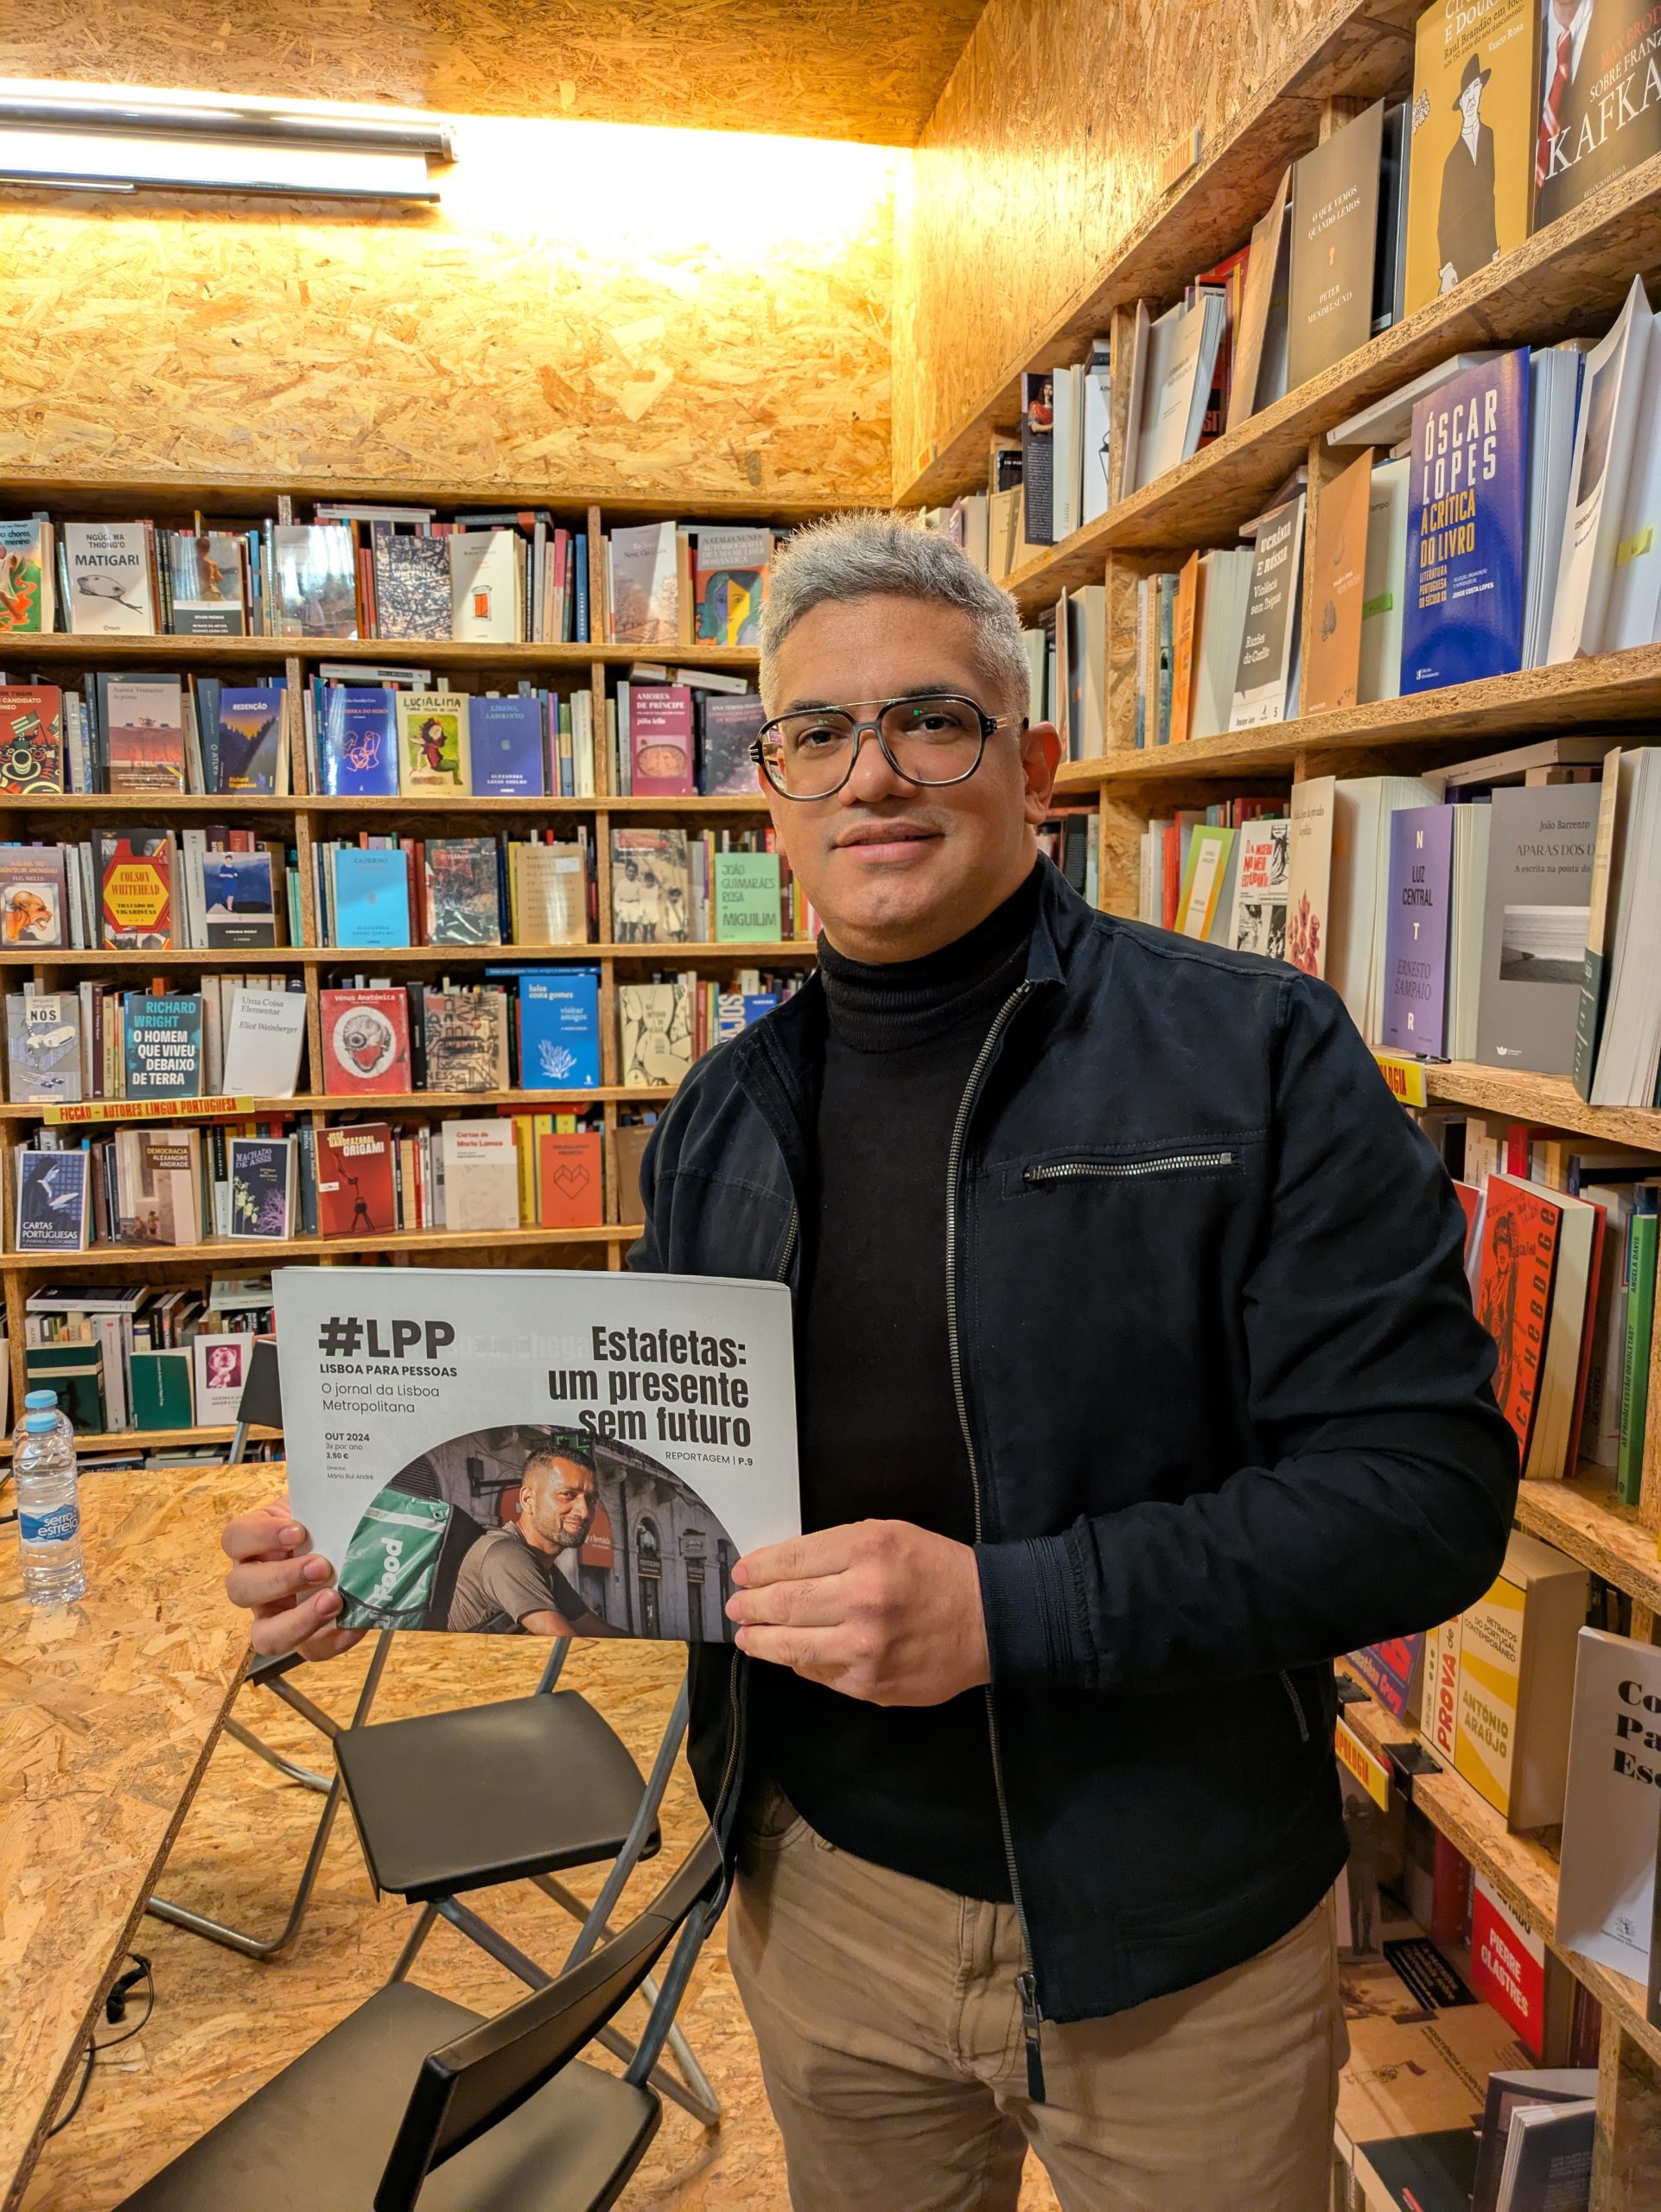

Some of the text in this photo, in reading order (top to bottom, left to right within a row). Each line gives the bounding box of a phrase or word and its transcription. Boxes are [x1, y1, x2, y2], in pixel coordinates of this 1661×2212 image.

[1492, 4, 1524, 32] nascimento
[1444, 38, 1460, 60] Raul
[1461, 16, 1492, 46] Brandão
[1493, 7, 1505, 20] em
[1488, 22, 1524, 53] Vasco Rosa
[1589, 63, 1622, 103] SOBRE
[1545, 57, 1661, 181] KAFKA
[1312, 185, 1358, 222] O QUE VEMOS
[1308, 198, 1360, 240] QUANDO LEMOS
[1319, 284, 1340, 303] PETER
[1308, 291, 1352, 324] MENDELSUND
[1424, 389, 1498, 462] ÓSCAR
[1422, 435, 1497, 506] LOPES
[1421, 487, 1476, 537] A CRÍTICA
[1261, 521, 1291, 553] UCRÂNIA
[1420, 522, 1475, 569] DO LIVRO
[75, 554, 139, 566] MATIGARI
[1257, 546, 1288, 576] E RÚSSIA
[1420, 563, 1448, 583] LITERATURA
[1419, 577, 1448, 596] PORTUGUESA
[1452, 582, 1494, 599] JORGE COSTA LOPES
[1245, 633, 1265, 648] Razões
[232, 702, 268, 710] REDENÇÃO
[648, 701, 685, 709] PRÍNCIPE
[1538, 820, 1590, 833] João Barrento
[1416, 830, 1423, 849] N
[1517, 843, 1585, 856] APARAS DOS
[120, 871, 150, 882] COLSON
[722, 864, 745, 875] JOÃO
[1411, 866, 1426, 883] LUZ
[1557, 865, 1579, 874] ponta
[111, 884, 160, 896] WHITEHEAD
[721, 876, 775, 889] GUIMARÃES
[722, 892, 744, 902] ROSA
[1402, 887, 1434, 907] CENTRAL
[722, 912, 776, 926] MIGUILIM
[1413, 922, 1420, 940] T
[1397, 958, 1431, 980] ERNESTO
[549, 992, 574, 1001] gomes
[1394, 977, 1432, 1002] SAMPAIO
[146, 1001, 196, 1014] RICHARD
[241, 1005, 281, 1015] Elementar
[242, 996, 283, 1007] Uma Coisa
[134, 1015, 179, 1027] WRIGHT
[239, 1020, 298, 1034] Eliot Weinberger
[560, 1014, 588, 1022] amigos
[1407, 1012, 1414, 1031] R
[133, 1030, 188, 1043] O HOMEM
[138, 1045, 195, 1058] QUE VIVEU
[146, 1058, 194, 1071] DEBAIXO
[132, 1072, 185, 1085] DE TERRA
[104, 1097, 238, 1119] AUTORES PORTUGUESA
[236, 1147, 272, 1162] MACHADO
[343, 1141, 385, 1156] ORIGAMI
[249, 1155, 272, 1166] ASSIS
[22, 1230, 78, 1239] PORTUGUESAS
[1631, 1259, 1639, 1294] ANGELA
[318, 1316, 455, 1359] #LPP
[591, 1325, 747, 1368] Estafetas:
[1626, 1325, 1634, 1374] OBSOLETAS?
[320, 1363, 458, 1377] LISBOA PARA PESSOAS
[321, 1382, 440, 1397] O jornal da Lisboa
[548, 1370, 749, 1408] um presente
[322, 1399, 415, 1414] Metropolitana
[578, 1406, 751, 1447] sem futuro
[1621, 1401, 1630, 1434] PRISÕES
[325, 1433, 370, 1442] OUT 2024
[1621, 1435, 1627, 1448] AS
[665, 1451, 754, 1466] REPORTAGEM P.9
[38, 1518, 78, 1537] estrela
[44, 1511, 74, 1528] serra
[1474, 1617, 1517, 1653] DO PORTUGAL
[1486, 1616, 1518, 1643] RETRATOS
[1464, 1618, 1516, 1663] CONTEMPORÂNEO
[1437, 1629, 1457, 1752] de PROVA
[1463, 1690, 1509, 1738] ANTÓNIO
[1464, 1711, 1507, 1758] ARAÚJO
[1490, 1927, 1521, 1983] PIERRE
[1480, 1944, 1529, 2018] CLASTRES
